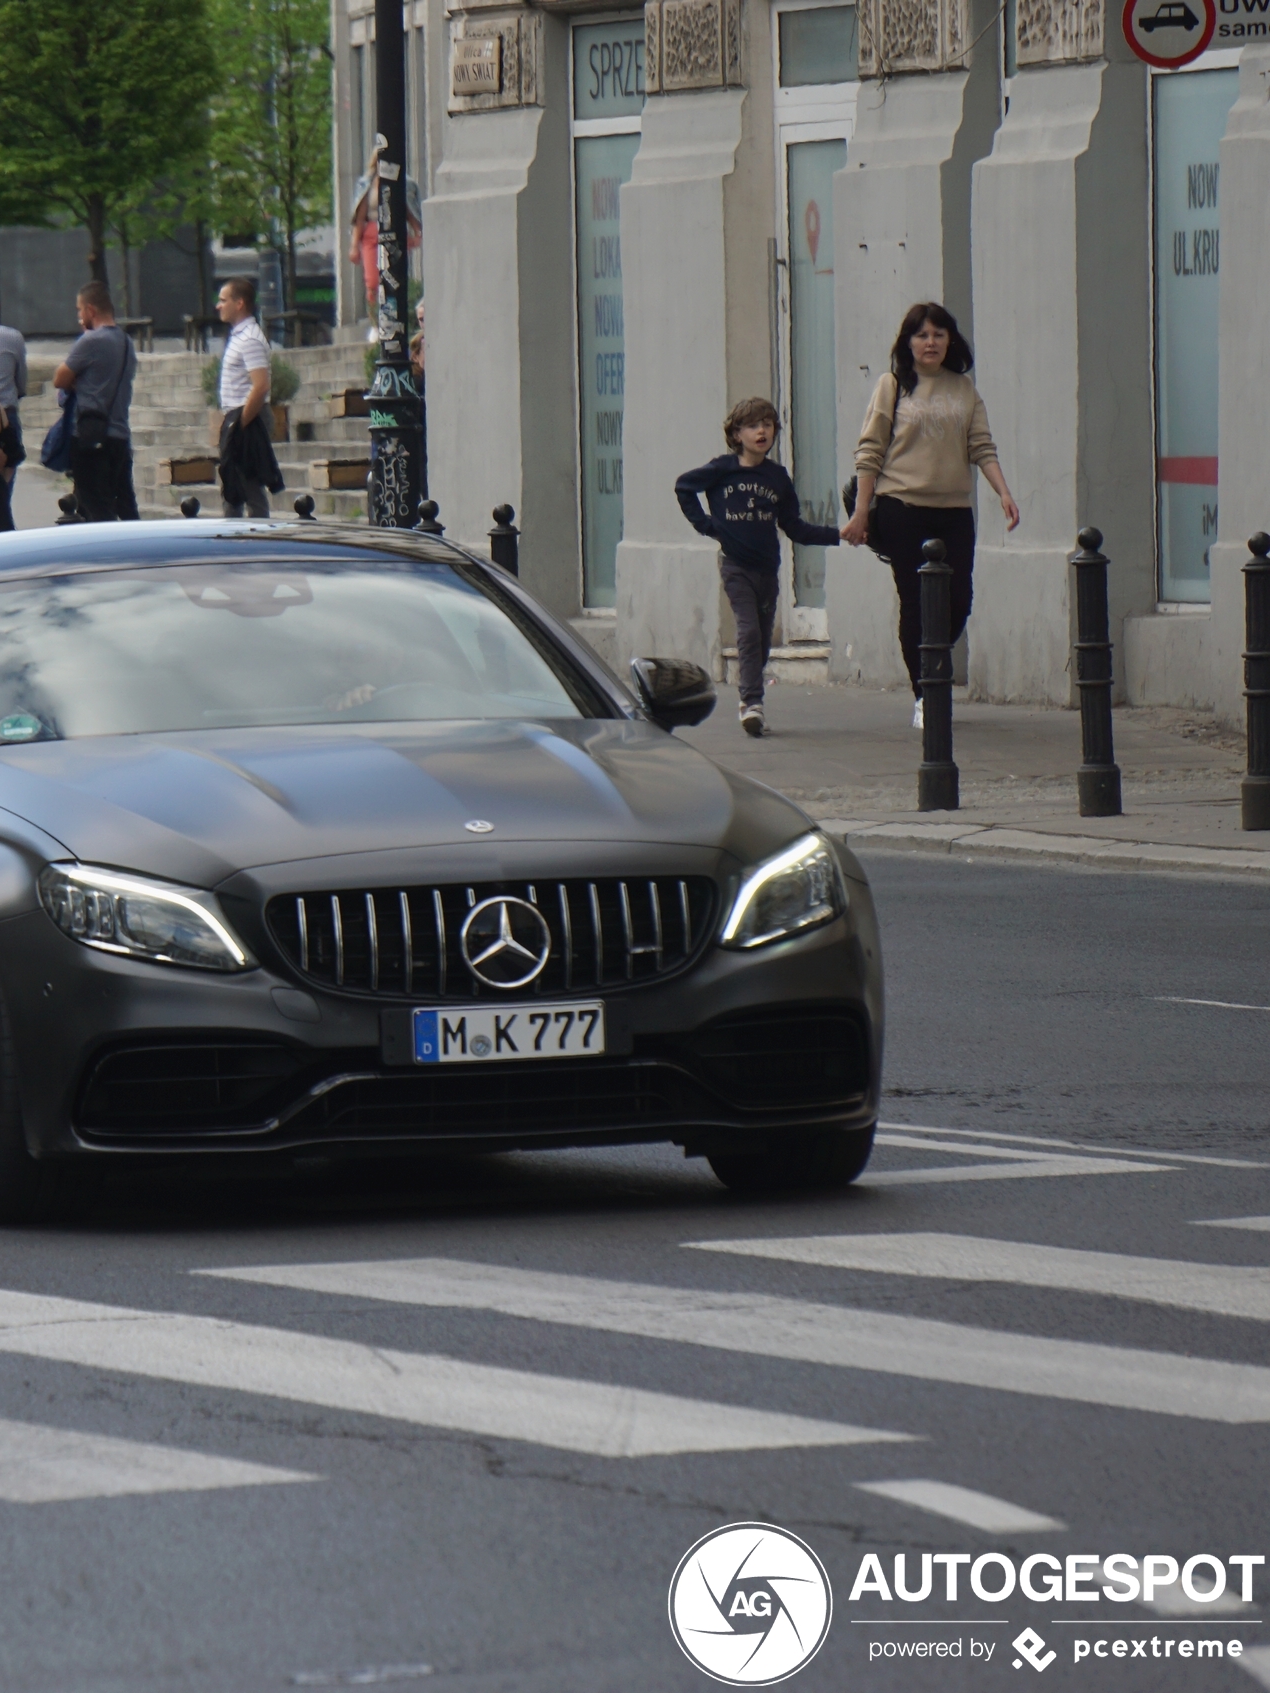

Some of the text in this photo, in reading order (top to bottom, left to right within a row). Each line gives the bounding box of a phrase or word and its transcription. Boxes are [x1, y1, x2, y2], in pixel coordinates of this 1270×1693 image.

[1219, 22, 1270, 38] sam
[592, 177, 623, 221] NOW
[1188, 163, 1219, 209] NOW
[596, 352, 625, 396] OFER
[596, 411, 624, 447] NOWY
[422, 1042, 432, 1054] D
[442, 1009, 600, 1055] M K 777
